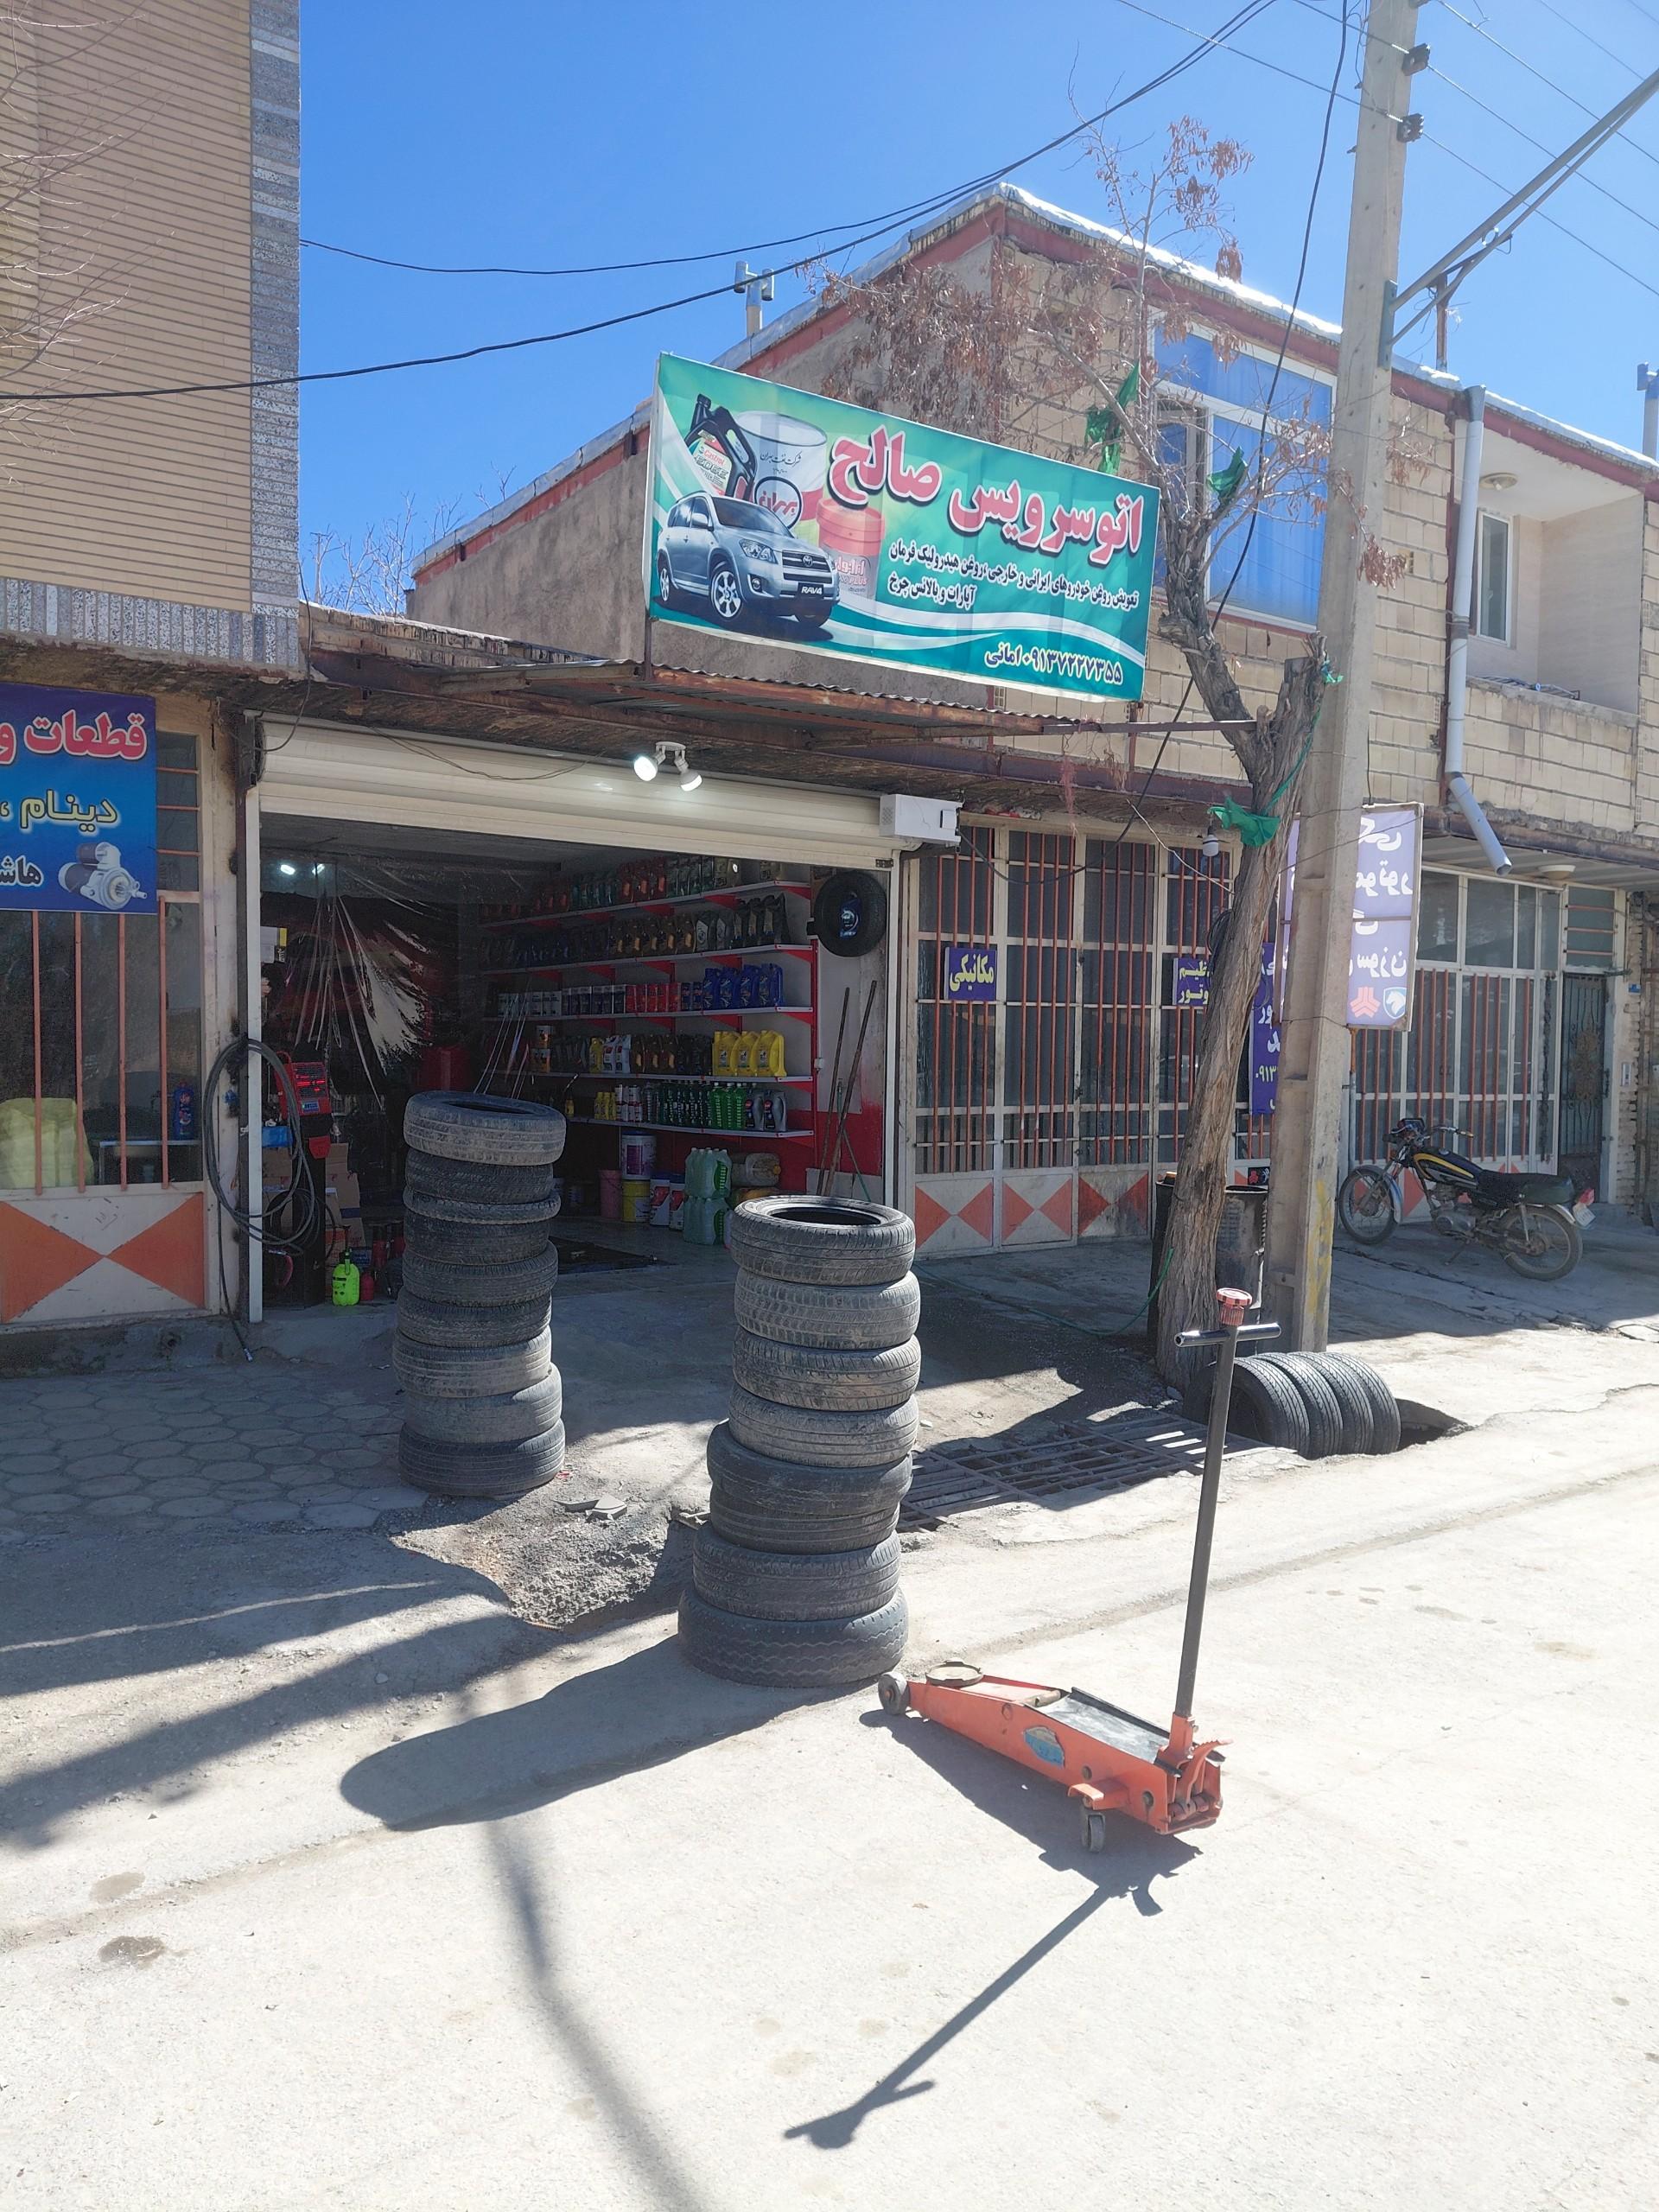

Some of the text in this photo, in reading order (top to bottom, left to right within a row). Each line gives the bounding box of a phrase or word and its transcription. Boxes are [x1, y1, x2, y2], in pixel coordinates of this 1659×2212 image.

[829, 424, 943, 506] صالح
[888, 537, 917, 564] فرمان
[916, 544, 959, 572] هیدرولیک
[887, 571, 911, 598] چرخ
[988, 563, 1018, 584] خارجی
[1018, 573, 1025, 588] و
[1025, 569, 1052, 593] ایرانی
[800, 586, 823, 595] RAV4
[910, 576, 939, 602] بالانس
[939, 590, 947, 604] و
[1051, 575, 1090, 600] خودروهای
[1091, 587, 1113, 607] روغن
[1112, 588, 1139, 610] تعویض
[984, 640, 1124, 685] ۰۹۱۳۷۲۲۷۳۵۵ امانی
[23, 709, 148, 760] قطعات
[20, 788, 119, 833] دینام
[949, 953, 995, 992] مکانیکی
[1177, 983, 1209, 1005] وتور
